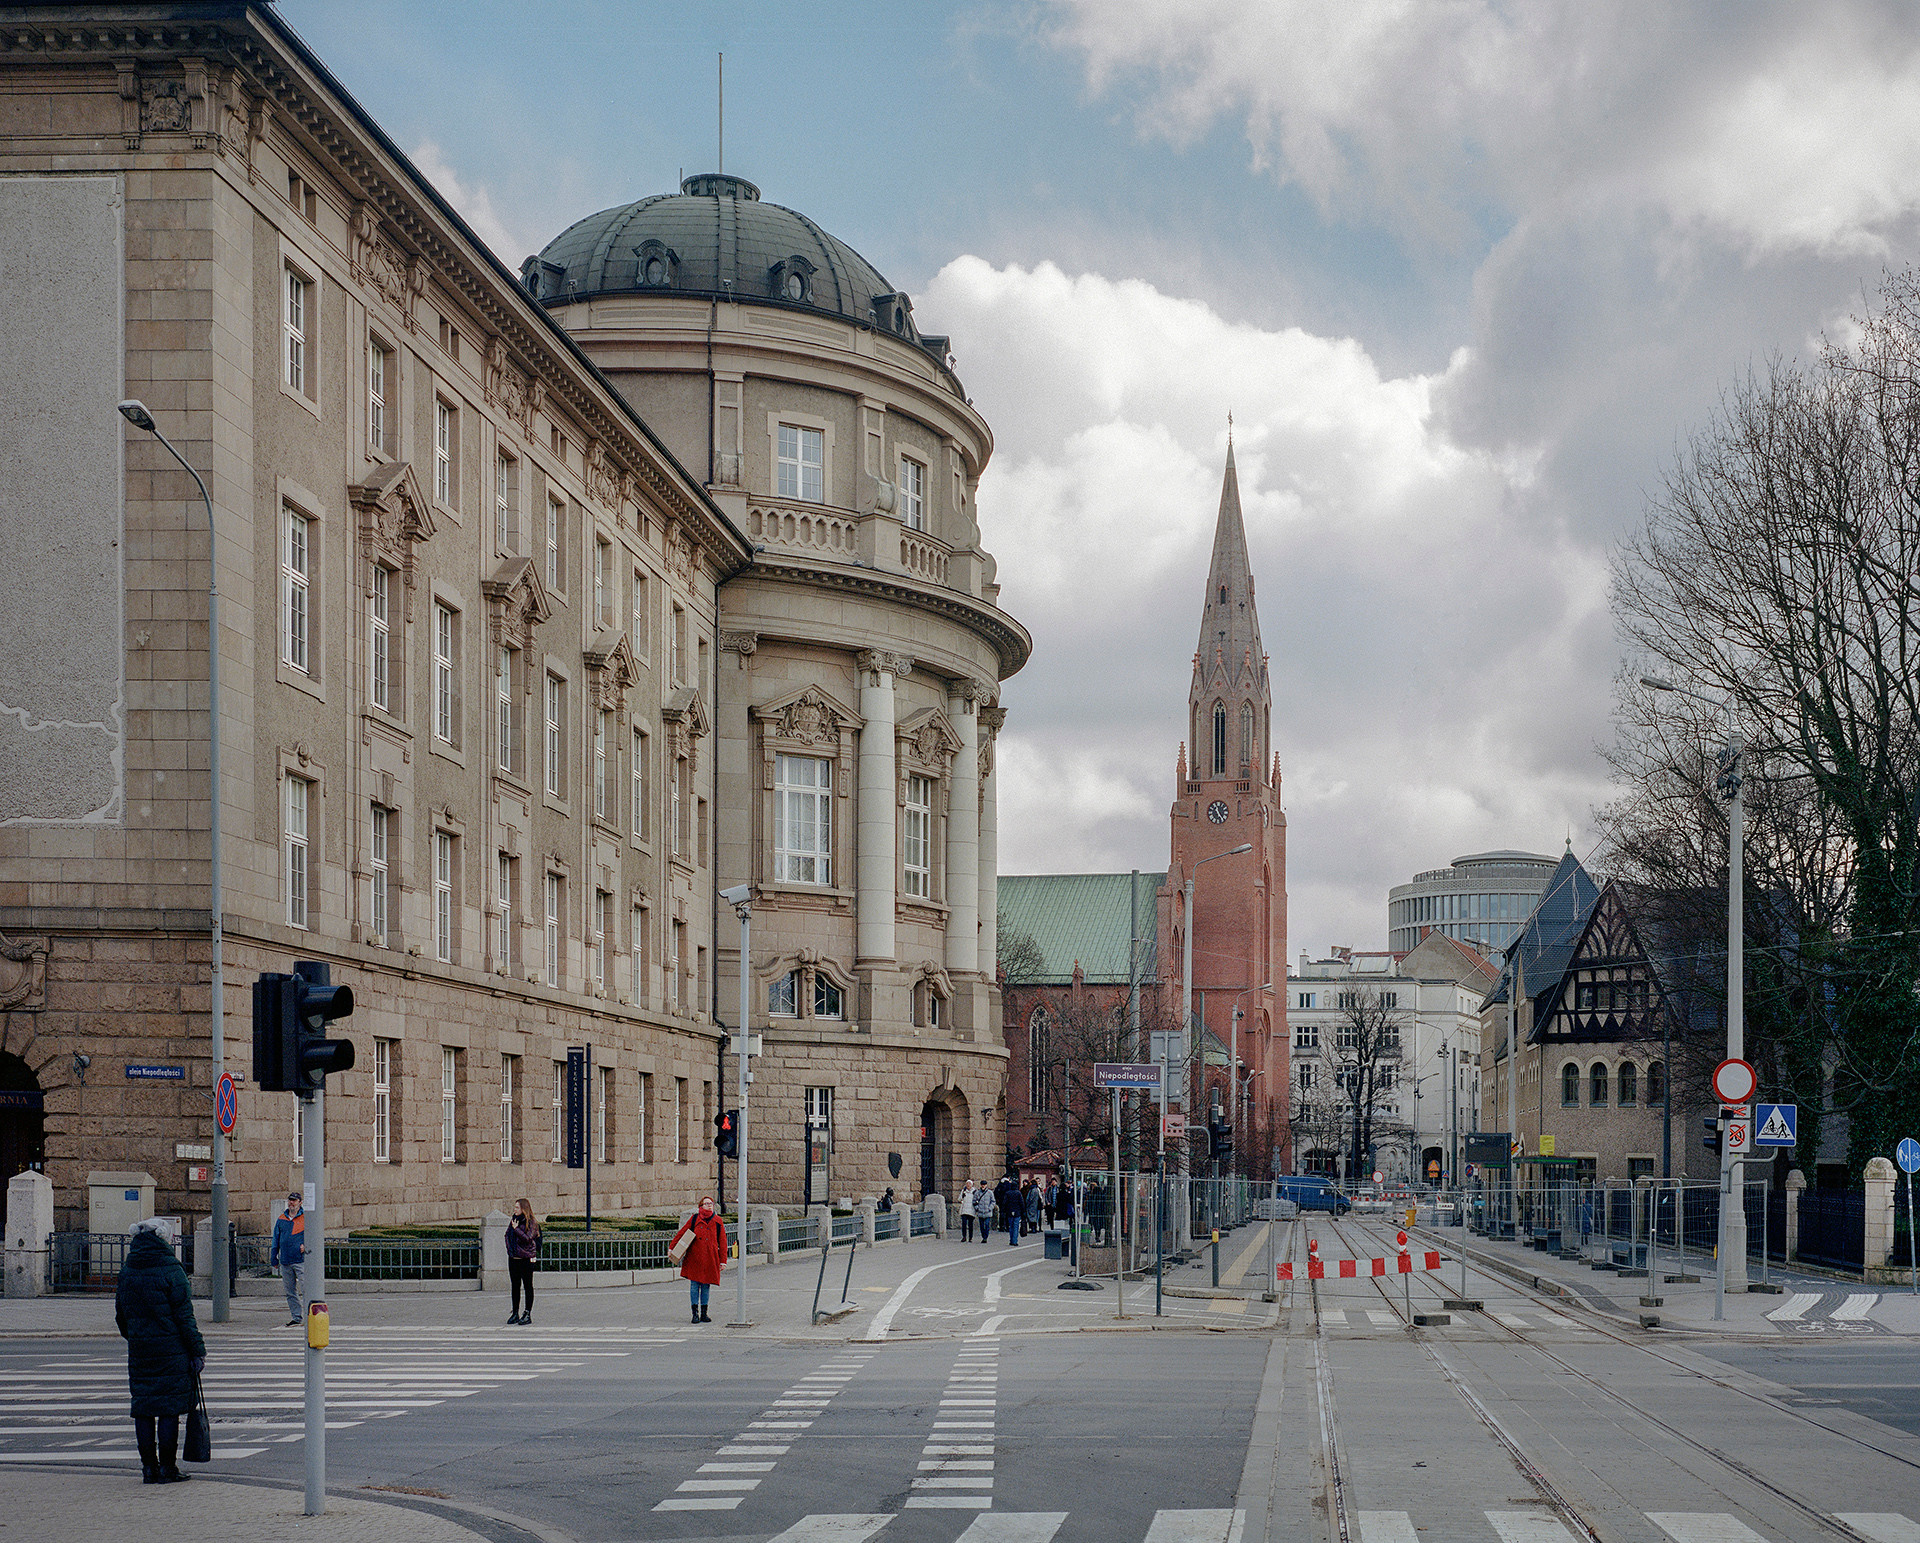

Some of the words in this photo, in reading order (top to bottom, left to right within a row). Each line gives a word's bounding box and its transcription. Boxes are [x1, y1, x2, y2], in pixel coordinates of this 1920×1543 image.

[129, 1067, 141, 1076] aleja
[142, 1068, 181, 1077] Niepodległości
[1099, 1071, 1157, 1081] Niepodległości
